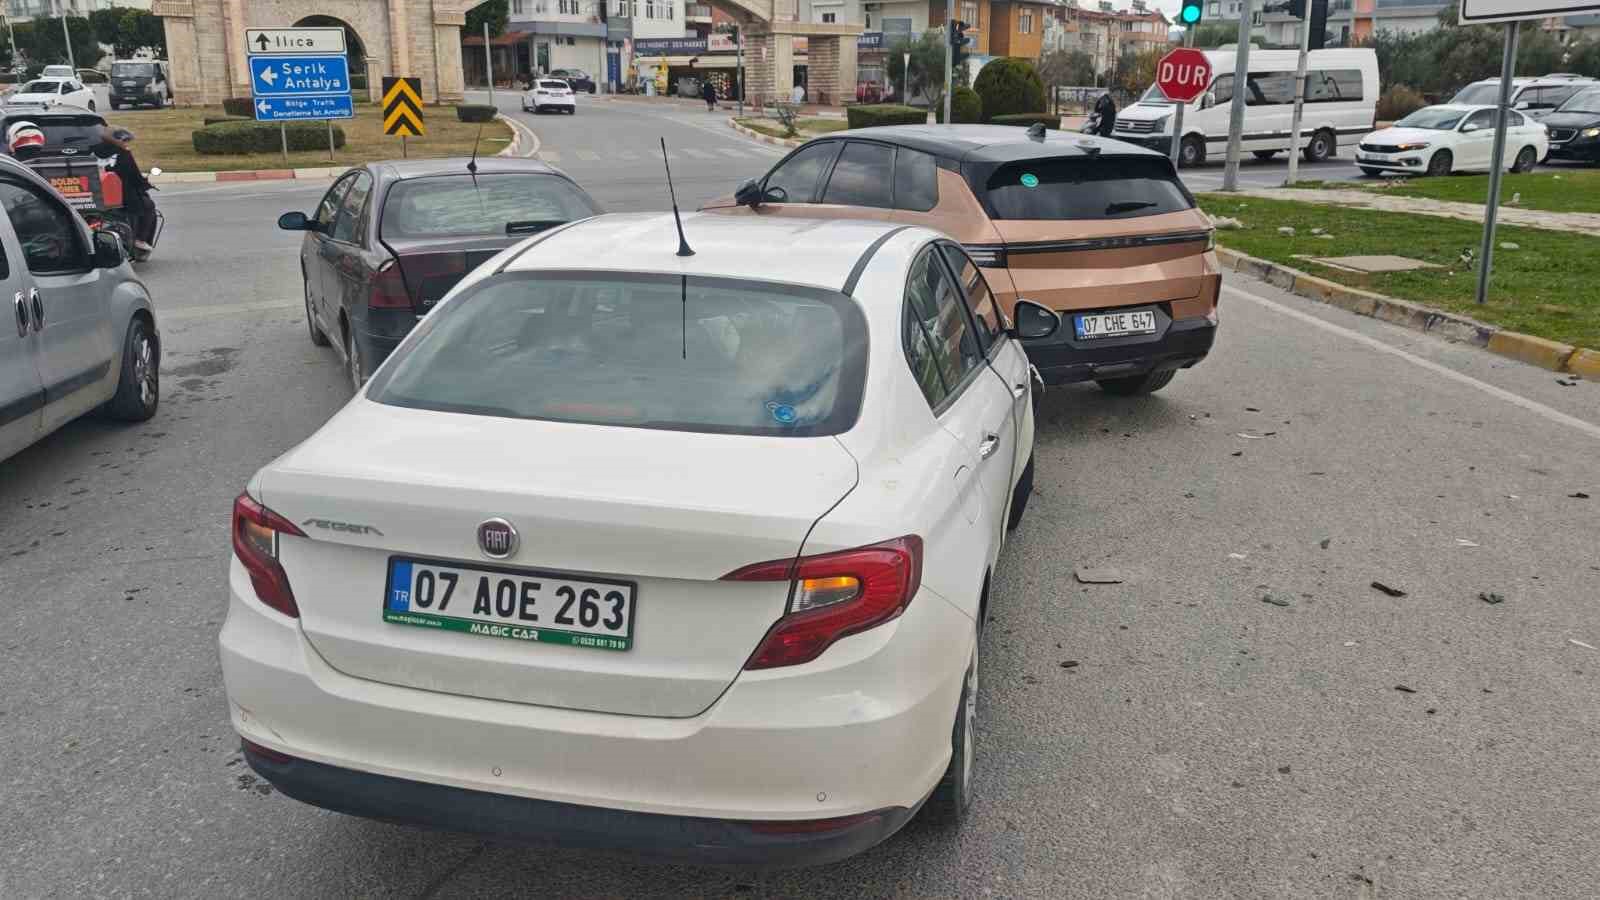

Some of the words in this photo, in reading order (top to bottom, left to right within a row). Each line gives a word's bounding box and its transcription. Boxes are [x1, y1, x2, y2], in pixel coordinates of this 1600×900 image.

[282, 62, 327, 75] Serik
[1160, 62, 1206, 86] DUR
[284, 77, 341, 91] Antalya
[1084, 317, 1097, 333] 07
[1104, 314, 1127, 331] CHE
[1132, 313, 1152, 329] 647
[484, 530, 508, 550] FIAT
[393, 590, 409, 602] TR
[415, 569, 459, 610] 07
[472, 575, 542, 622] AOE
[554, 585, 625, 631] 263
[470, 624, 510, 637] MAGIC
[511, 628, 539, 641] CAR
